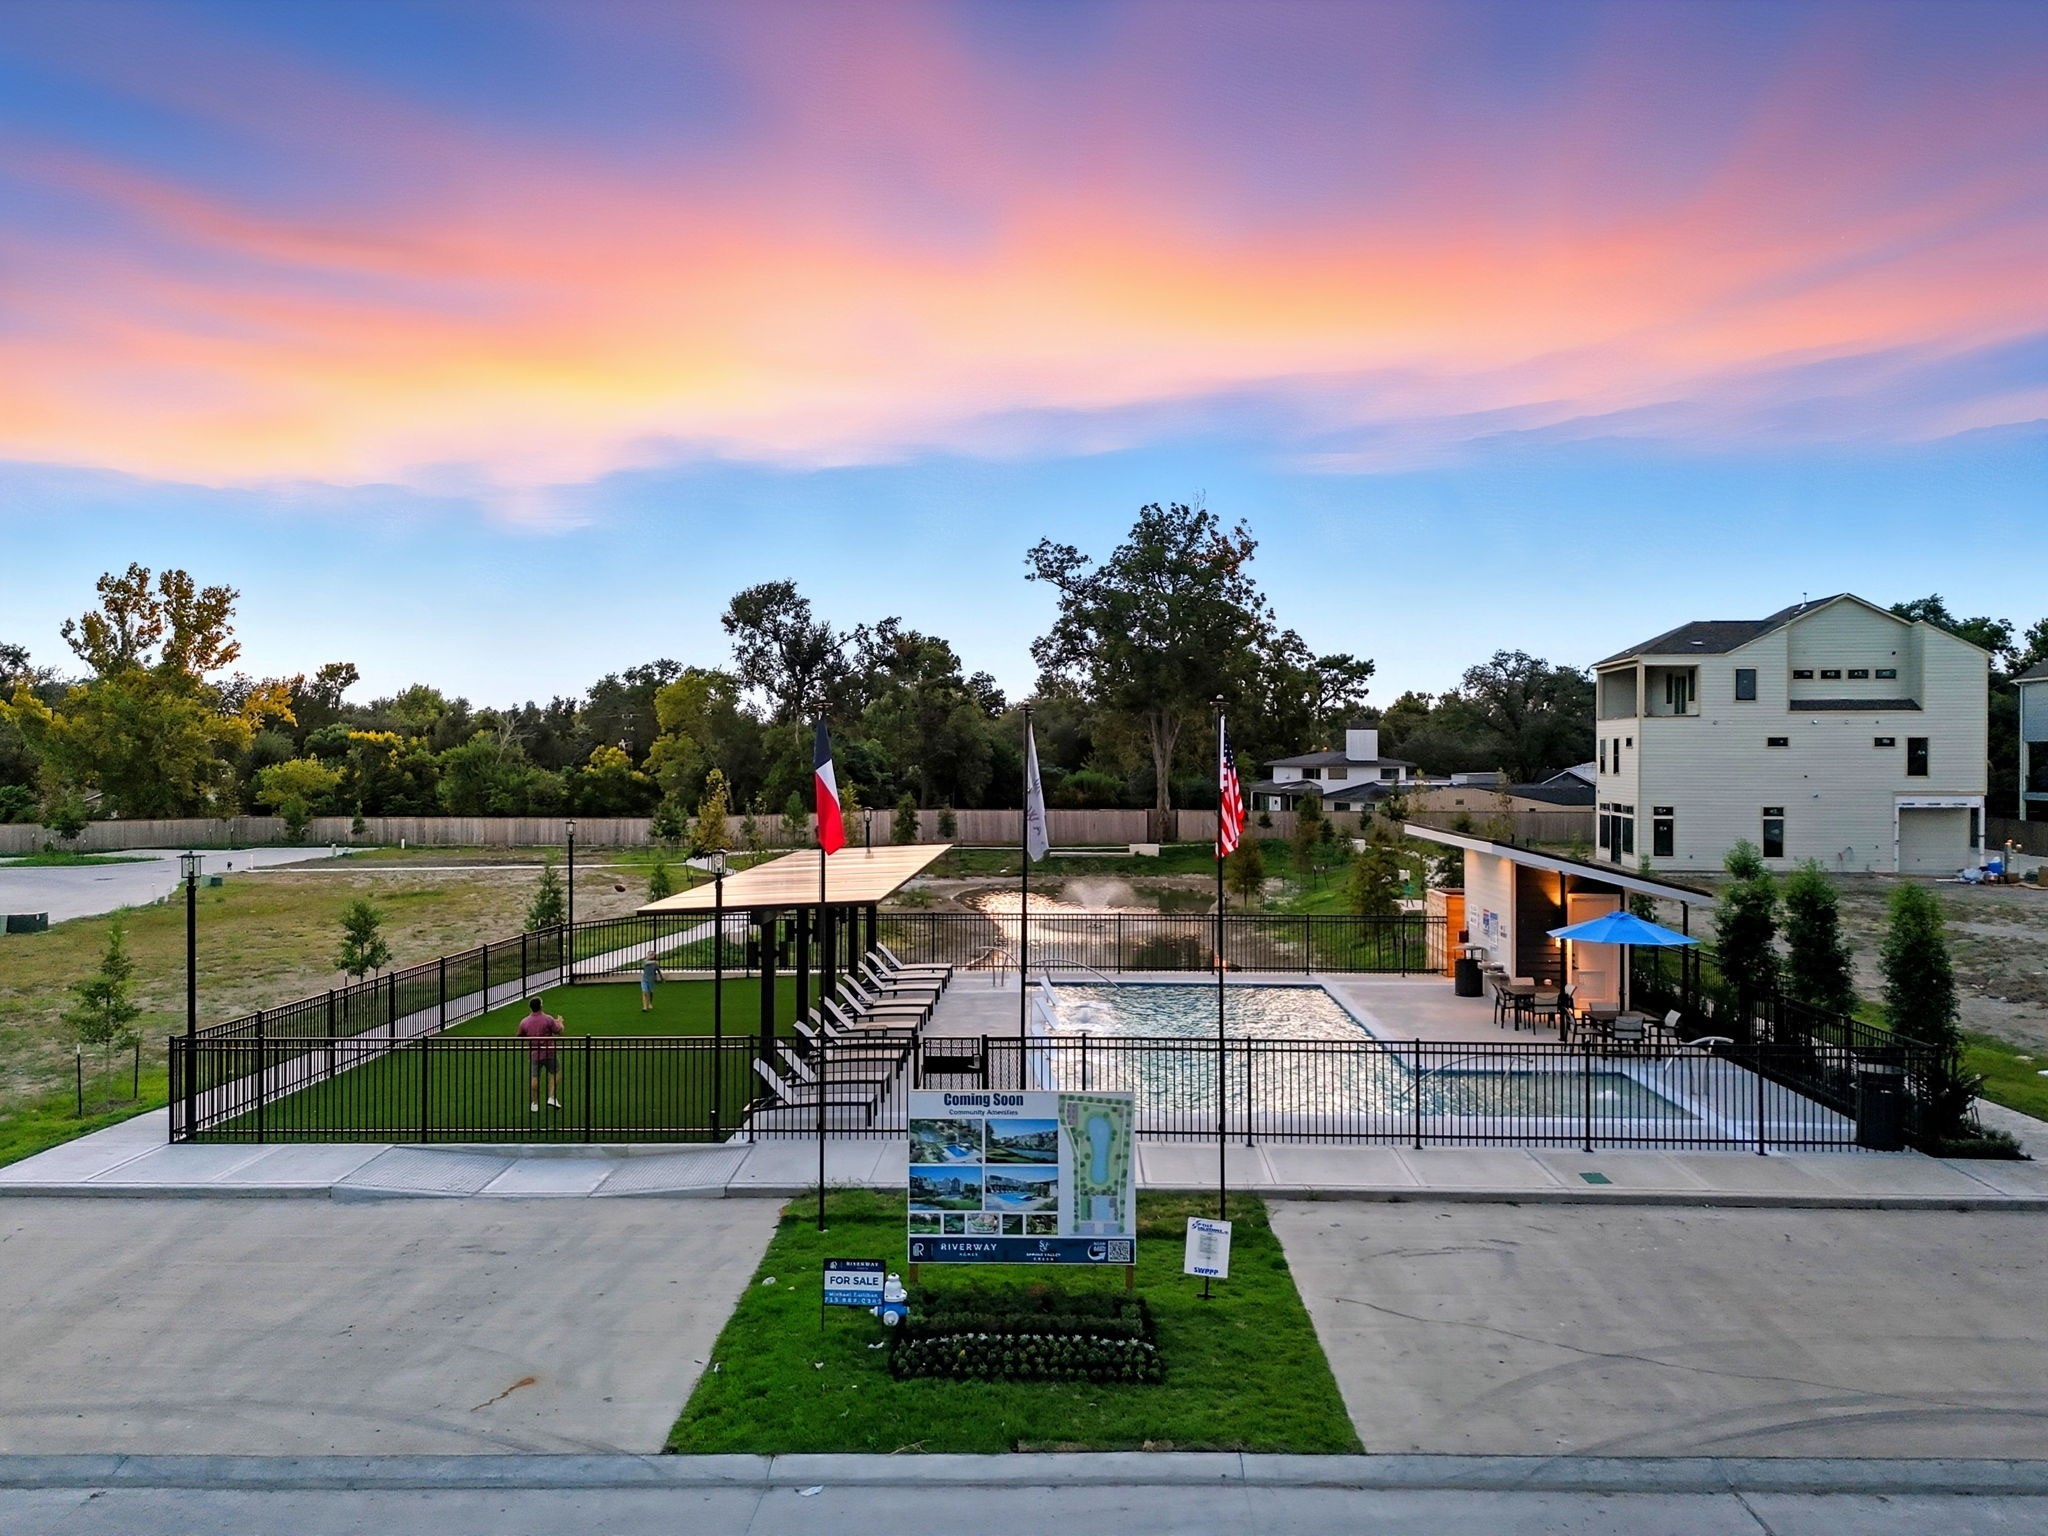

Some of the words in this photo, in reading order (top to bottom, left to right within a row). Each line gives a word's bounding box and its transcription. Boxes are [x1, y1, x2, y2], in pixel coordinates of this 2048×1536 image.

[944, 1093, 990, 1107] Coming
[993, 1093, 1024, 1106] Soon
[940, 1243, 997, 1251] RIVERWAY
[1193, 1266, 1219, 1275] SWPPP
[830, 1276, 850, 1285] FOR
[853, 1276, 879, 1286] SALE
